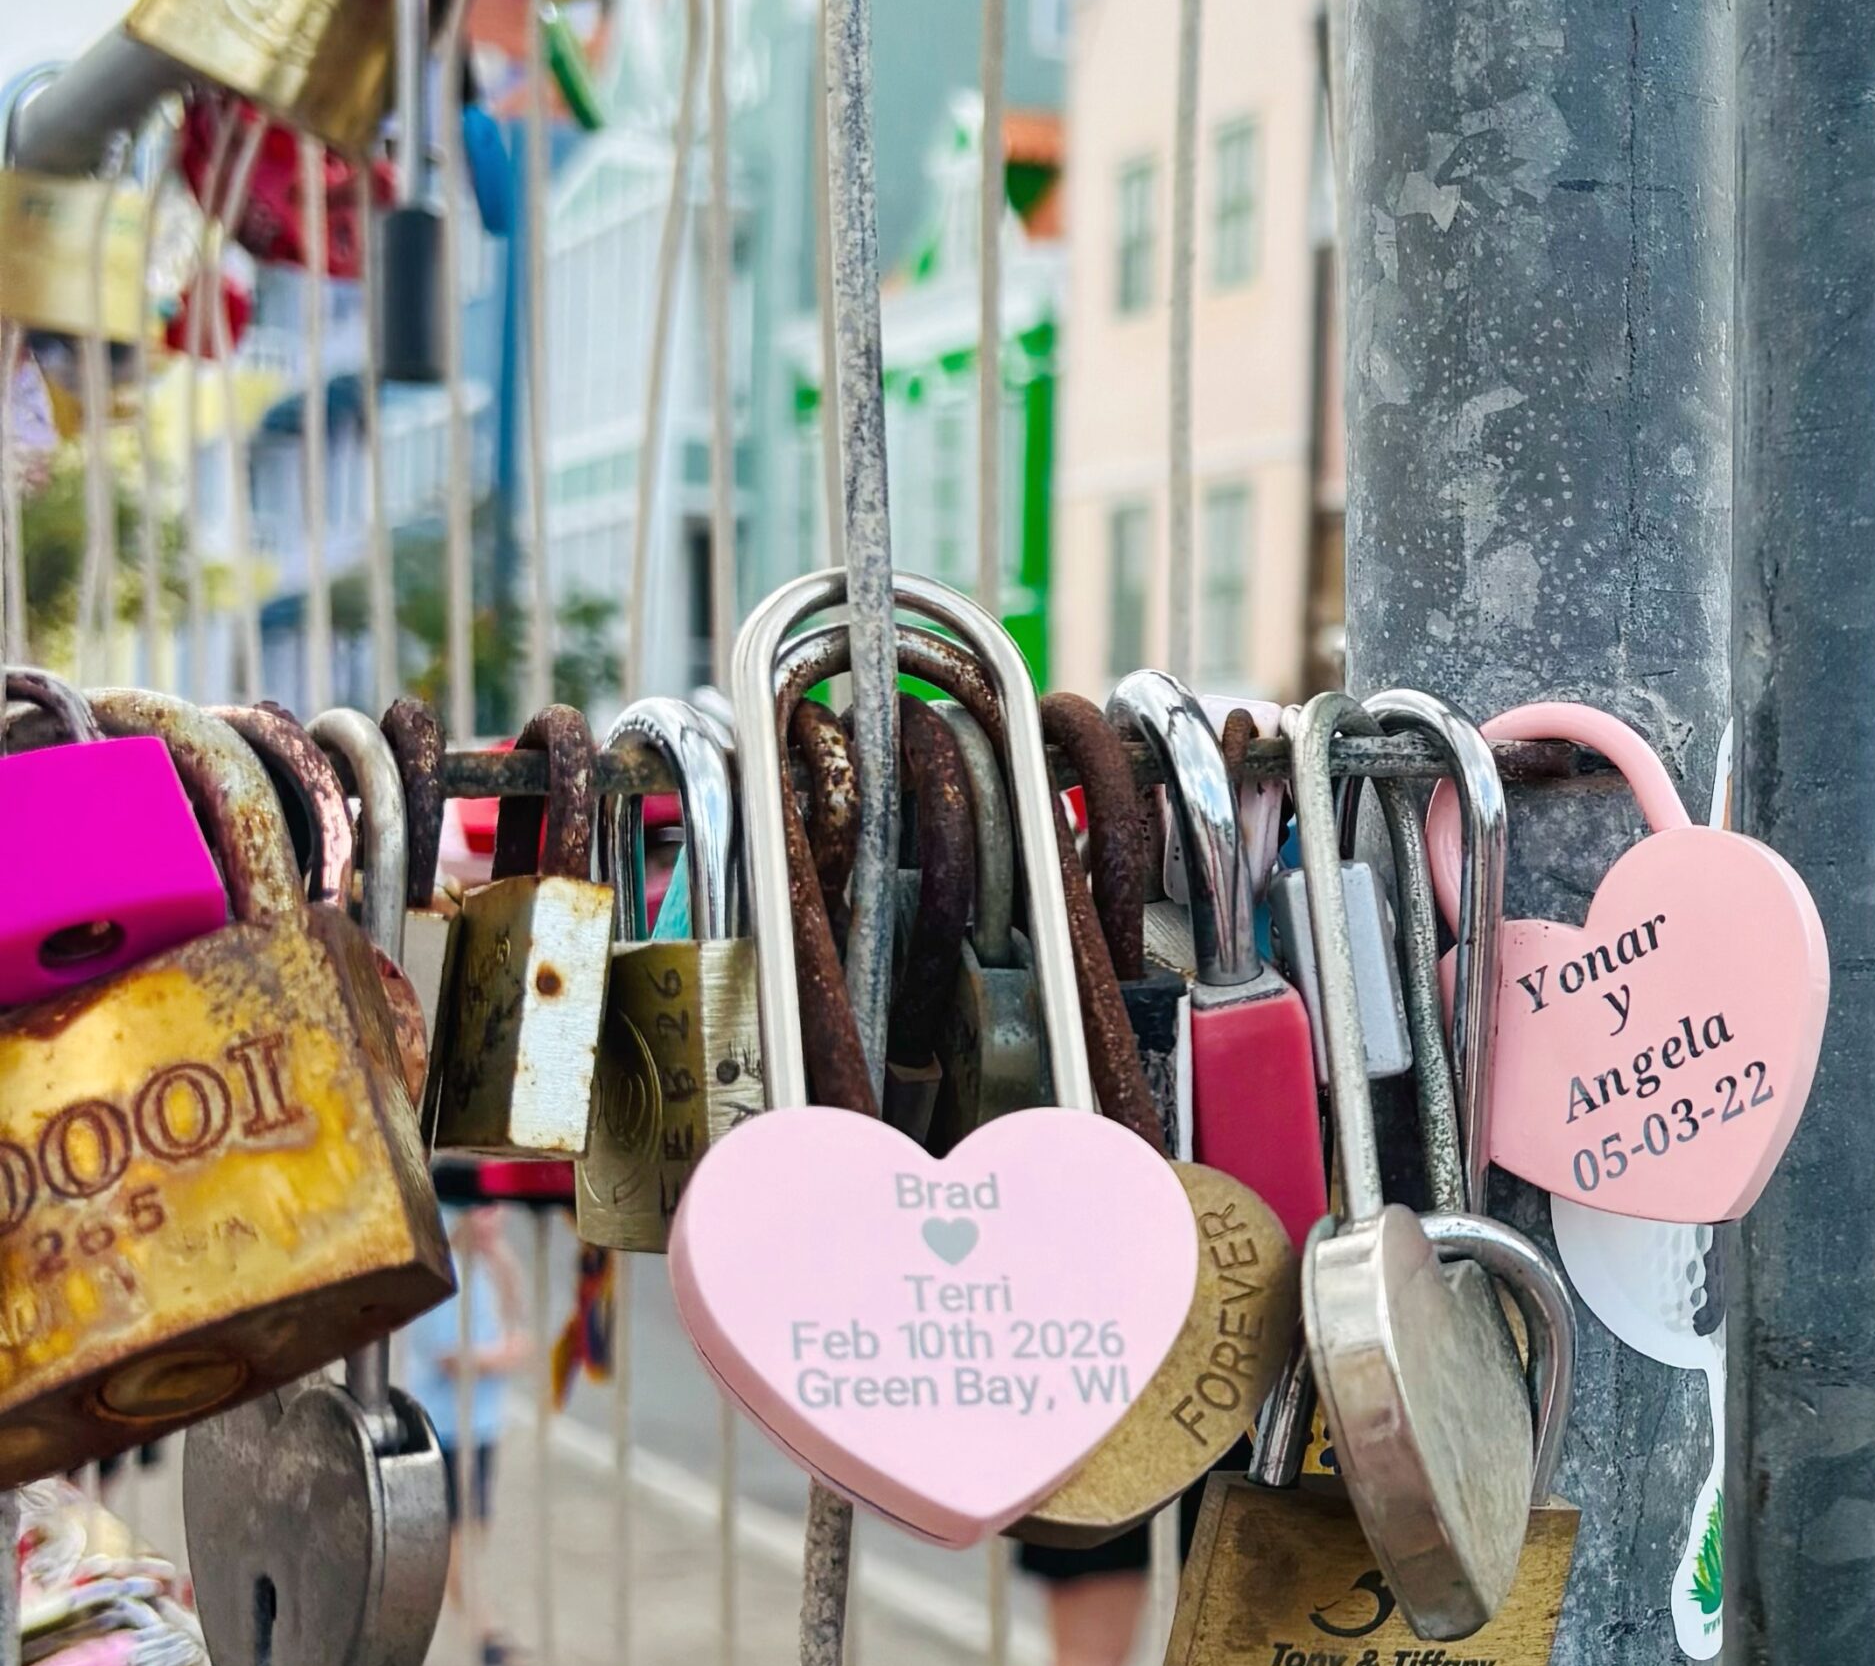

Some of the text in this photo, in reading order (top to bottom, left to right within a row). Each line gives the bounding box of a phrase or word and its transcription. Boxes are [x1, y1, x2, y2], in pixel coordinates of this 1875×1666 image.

[1516, 913, 1666, 1014] Yonar
[1602, 983, 1632, 1037] y
[1566, 1011, 1735, 1124] Angela
[1573, 1060, 1775, 1192] 05-03-22
[895, 1173, 1001, 1210] Brad
[904, 1275, 1013, 1313] Terri
[791, 1320, 1126, 1361] Feb 10th 2026
[1170, 1202, 1266, 1447] FOREVER
[799, 1369, 938, 1408] Green
[1071, 1365, 1131, 1404] WI
